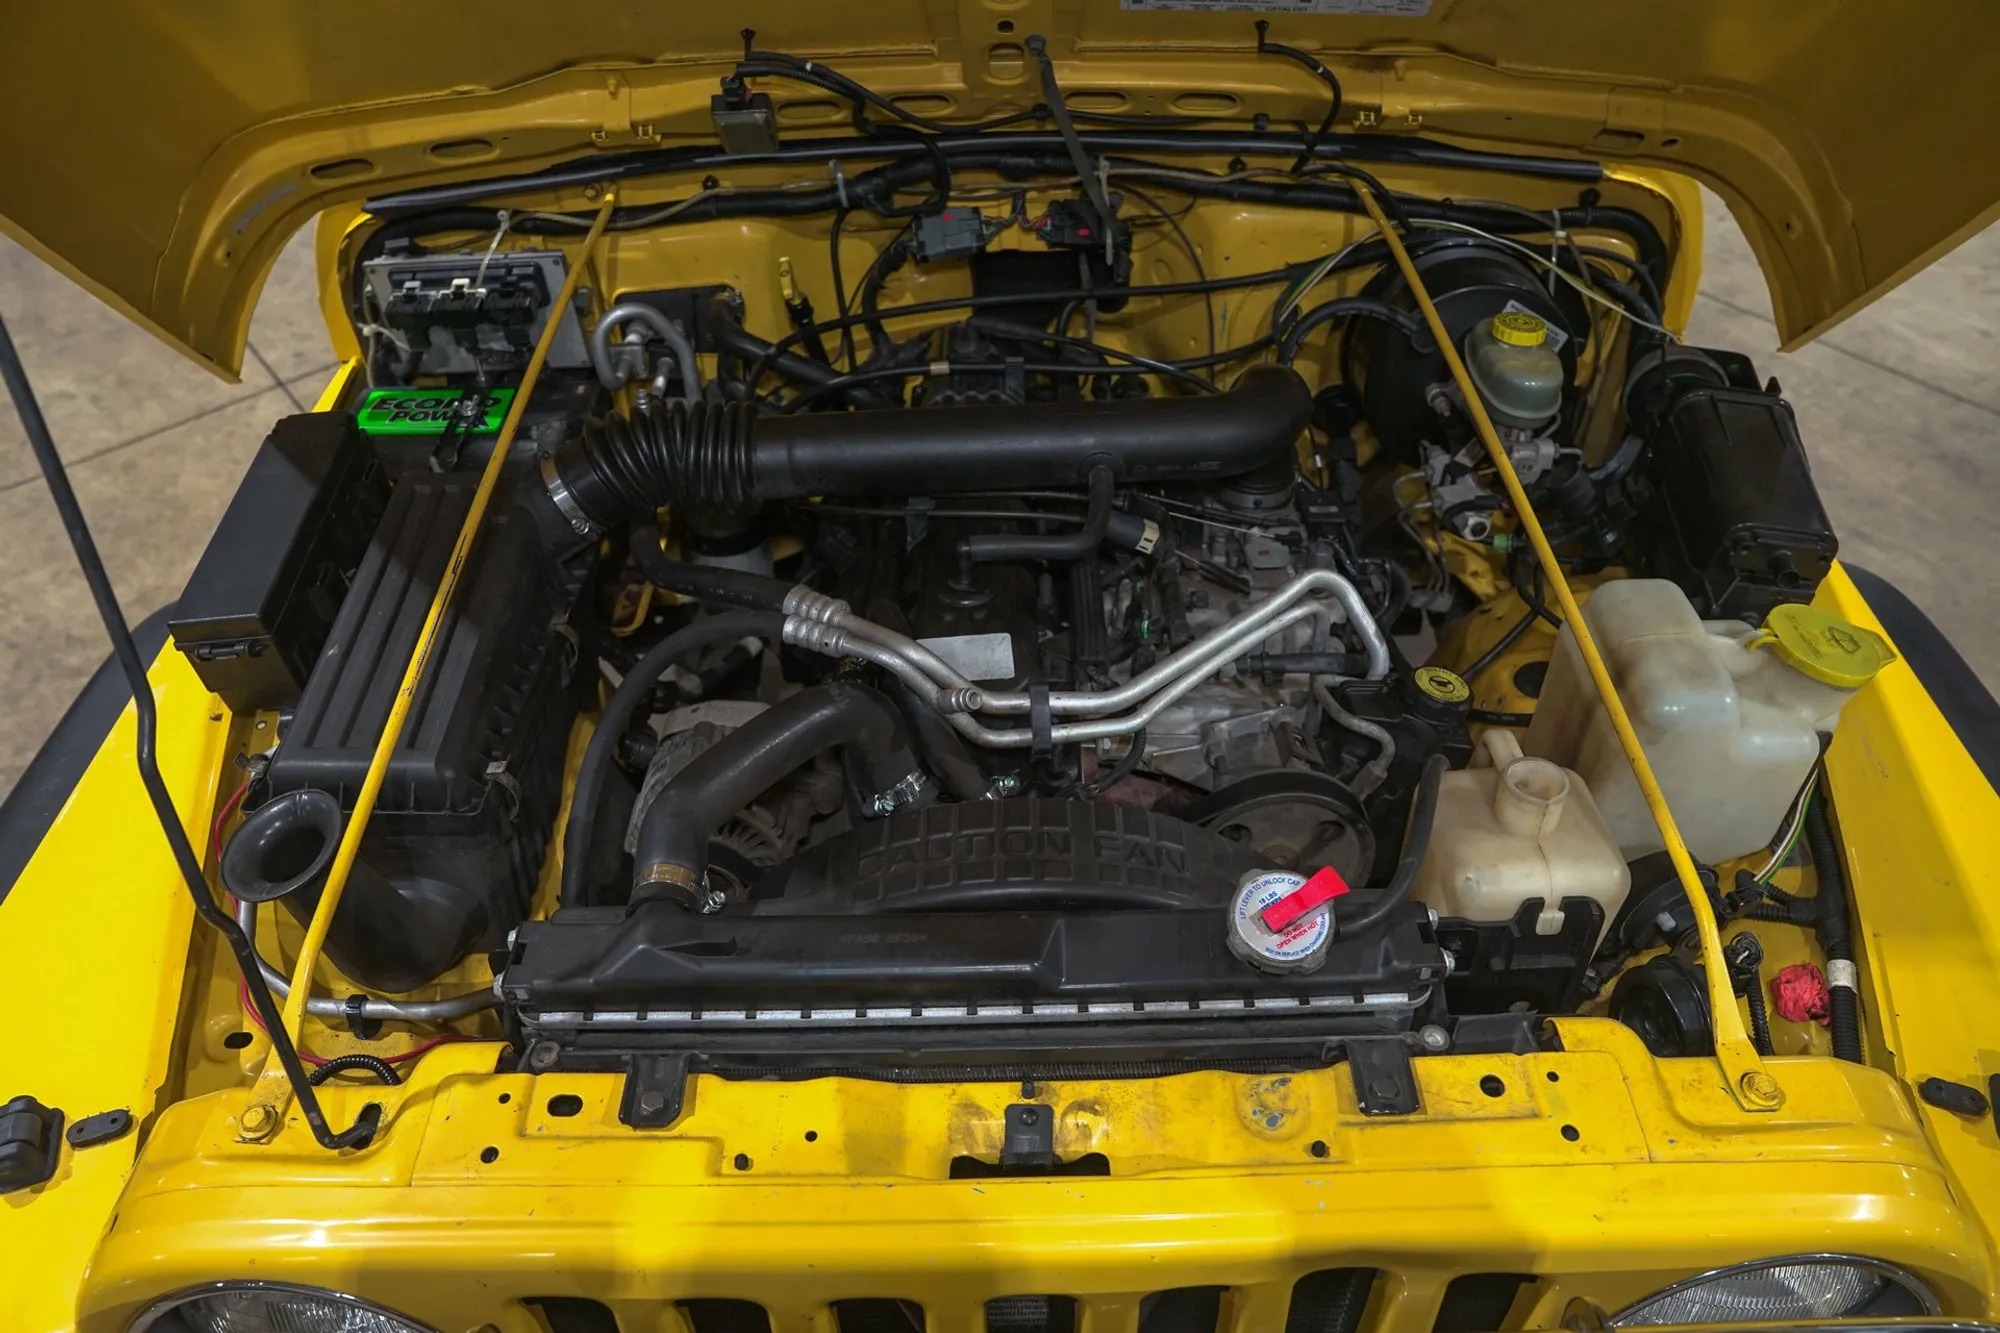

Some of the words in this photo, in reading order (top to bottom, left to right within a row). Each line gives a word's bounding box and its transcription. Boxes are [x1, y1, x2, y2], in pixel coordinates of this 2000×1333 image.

[859, 830, 1072, 878] CAUTION
[1094, 830, 1191, 876] FAN
[1241, 889, 1255, 907] LEVER
[1253, 883, 1262, 891] TO
[1260, 876, 1287, 887] UNLOCK
[1287, 877, 1301, 886] CAP
[1265, 890, 1278, 901] LBS
[1276, 938, 1292, 949] OPEN
[1291, 928, 1307, 940] WHEN
[1306, 921, 1318, 932] HOT
[1283, 930, 1292, 938] DO
[1292, 923, 1304, 932] NOT
